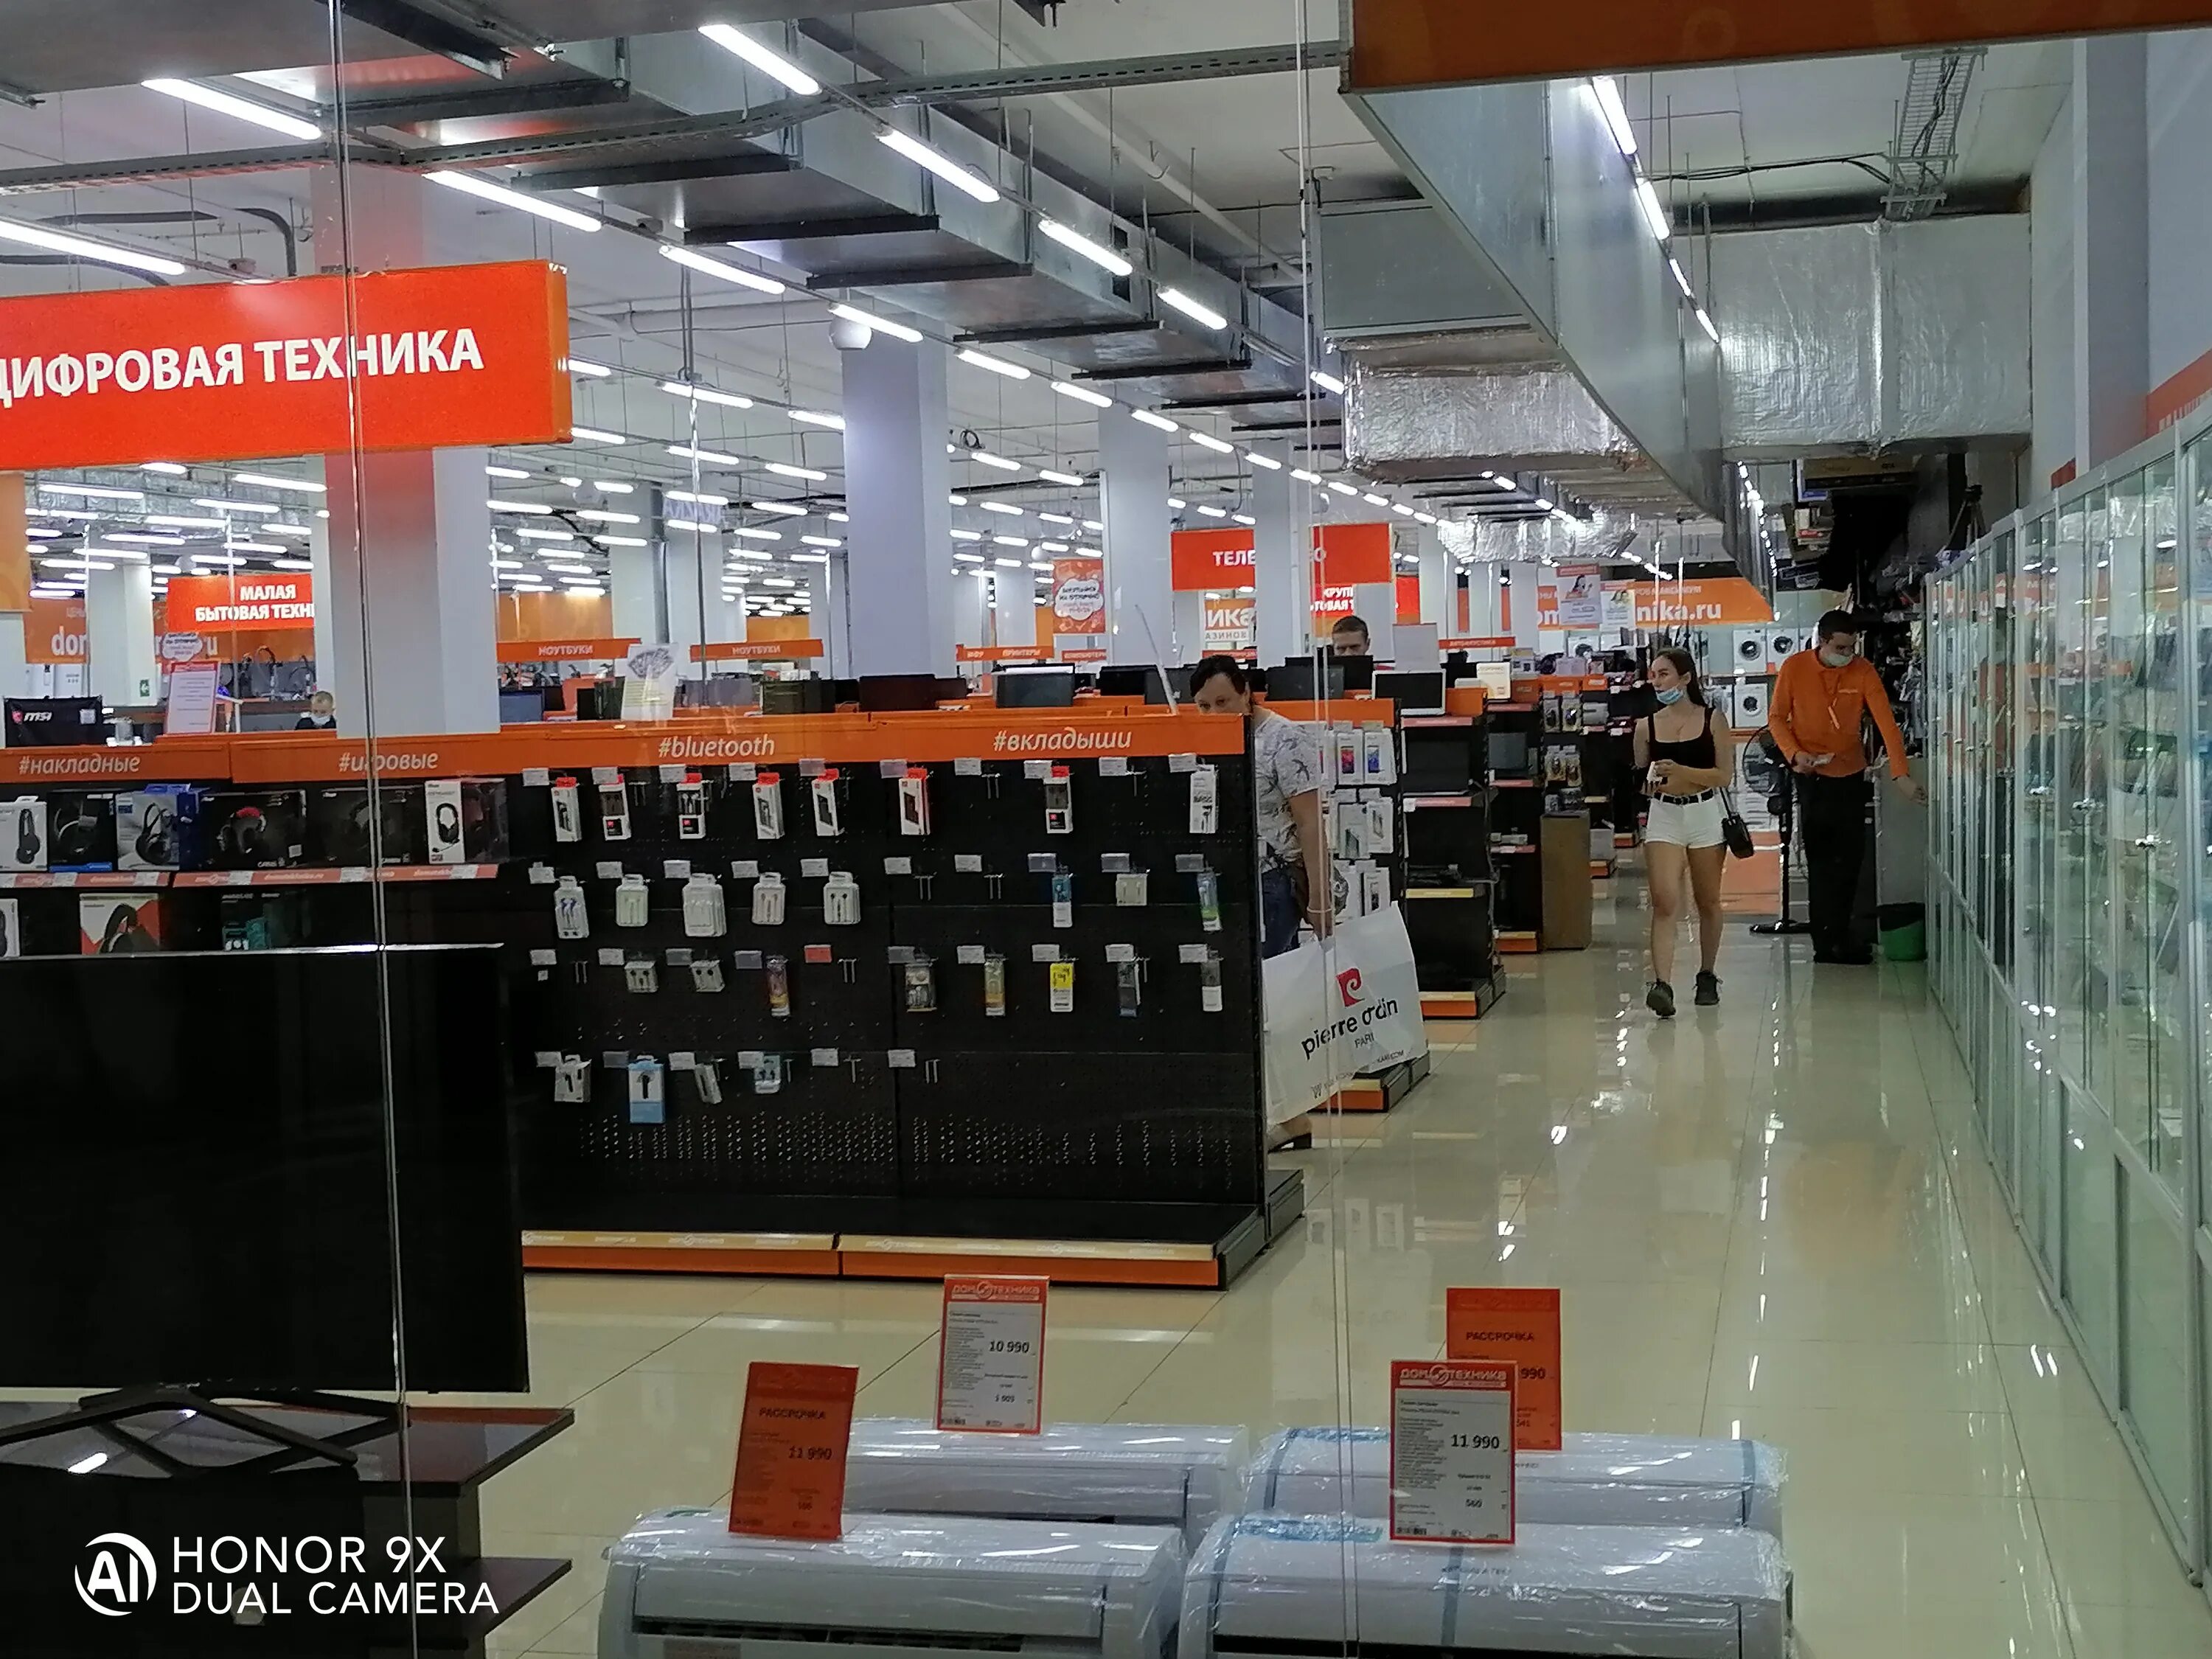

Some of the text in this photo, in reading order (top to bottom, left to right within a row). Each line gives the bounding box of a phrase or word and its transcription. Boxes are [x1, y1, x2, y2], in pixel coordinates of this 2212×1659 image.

[254, 327, 484, 383] ТЕХНИКА
[240, 584, 296, 601] МАЛАЯ
[195, 604, 270, 622] БЫТОВАЯ
[1637, 599, 1722, 622] nika.ru
[538, 645, 594, 656] НОУТБУКИ
[732, 644, 781, 655] НОУТБУКИ
[658, 734, 776, 759] #bluetooth
[993, 727, 1132, 752] #вкладыши
[18, 754, 141, 776] #накладные
[1301, 1017, 1357, 1060] pierre
[990, 1340, 1030, 1354] 10 990
[1521, 1367, 1546, 1380] 990
[1451, 1434, 1500, 1450] 11 990
[788, 1444, 832, 1461] 11 990
